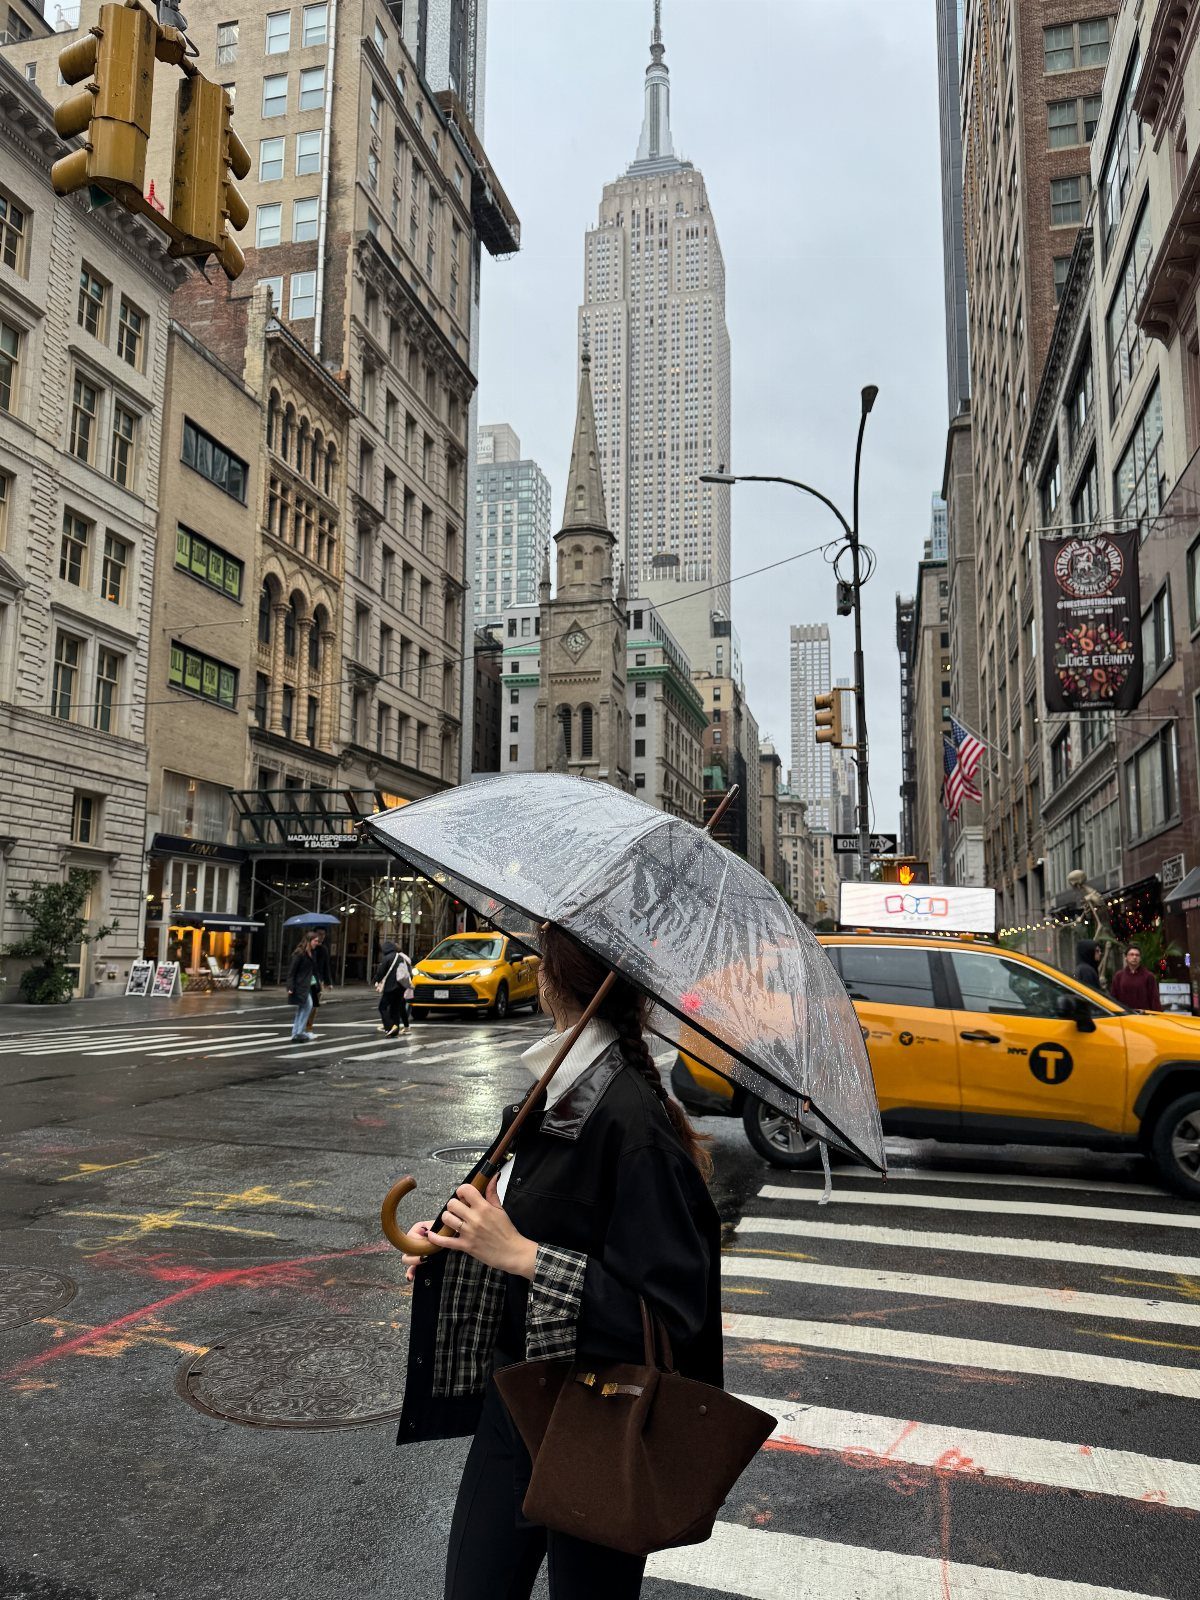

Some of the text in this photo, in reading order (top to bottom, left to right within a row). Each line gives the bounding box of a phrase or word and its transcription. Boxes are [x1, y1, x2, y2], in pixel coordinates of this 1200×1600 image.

[1057, 541, 1080, 576] STRONG
[1106, 545, 1121, 571] YORK
[1057, 653, 1135, 667] JUICE ETERNITY
[287, 834, 358, 842] MADMAN ESPRESSO
[1007, 1047, 1028, 1055] NYC
[1038, 1050, 1064, 1080] T
